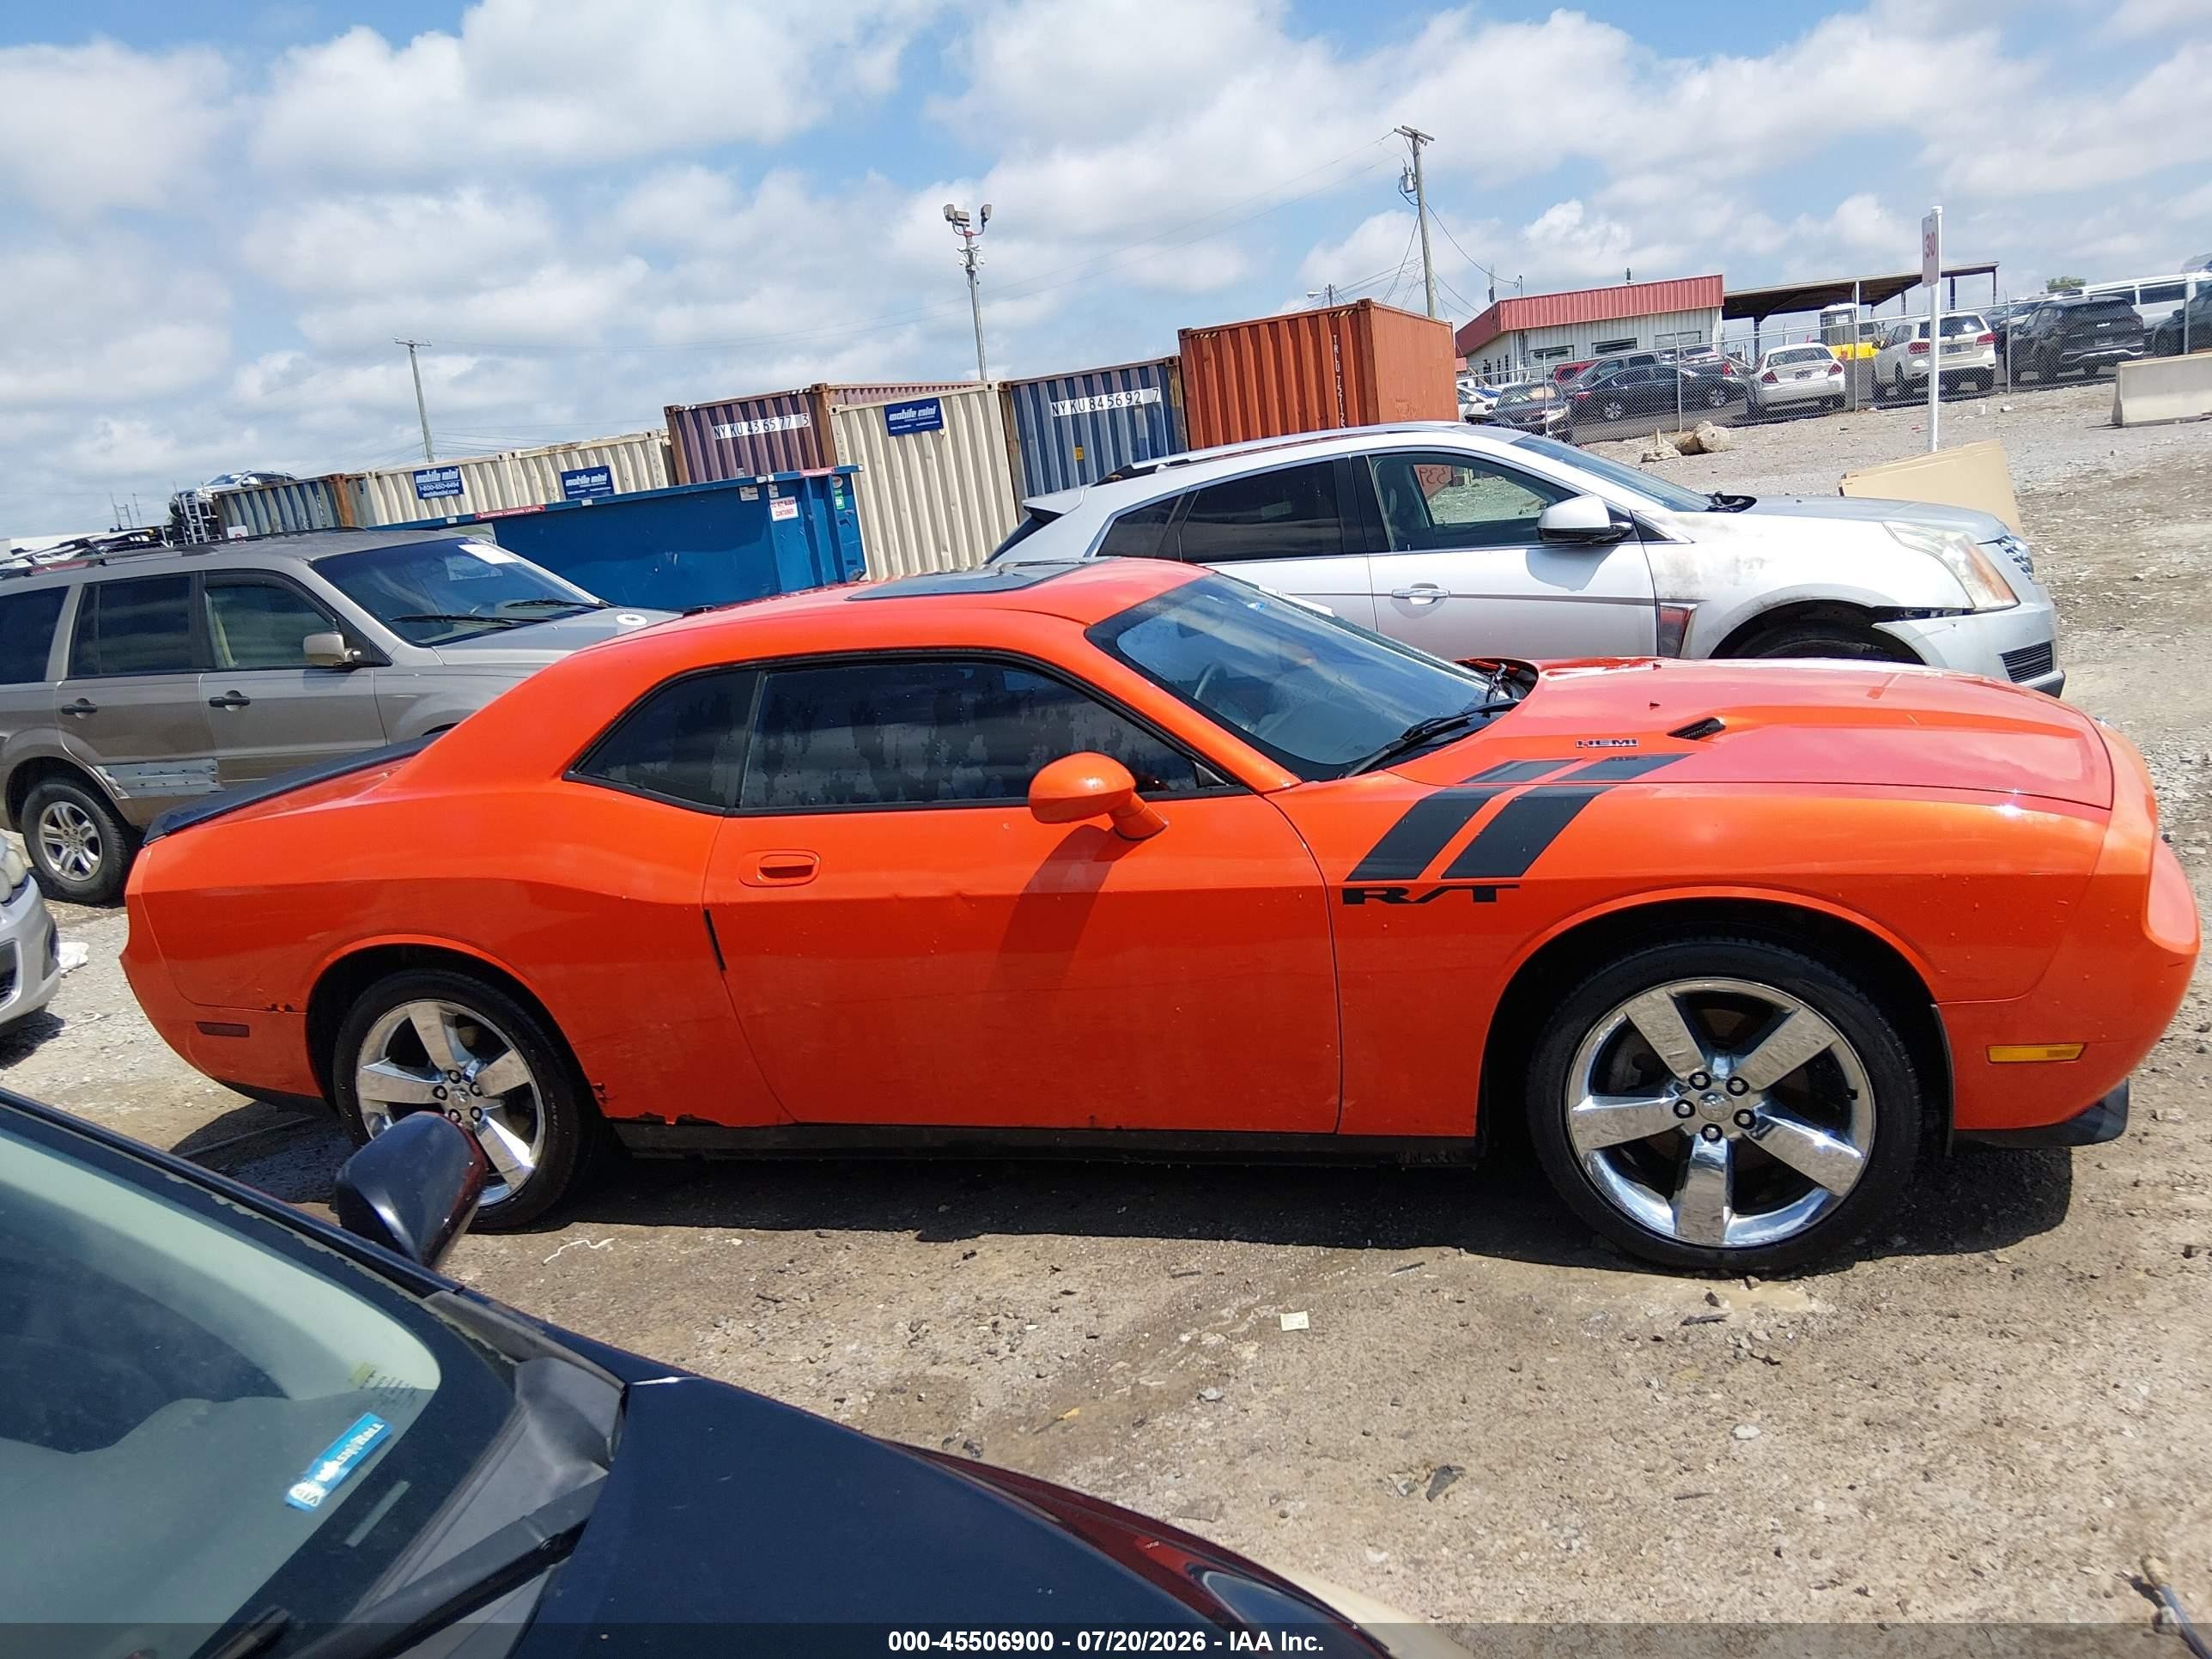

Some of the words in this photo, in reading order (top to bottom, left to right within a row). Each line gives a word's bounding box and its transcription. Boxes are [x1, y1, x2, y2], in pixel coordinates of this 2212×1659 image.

[1925, 232, 1936, 258] 30
[802, 414, 809, 426] 3
[889, 407, 916, 421] mobile
[918, 405, 938, 416] mini
[416, 470, 441, 483] mobile
[441, 468, 459, 480] mini
[565, 474, 590, 486] mobile
[591, 472, 607, 483] mini
[1576, 738, 1638, 749] HEMI
[1341, 884, 1520, 904] R/T
